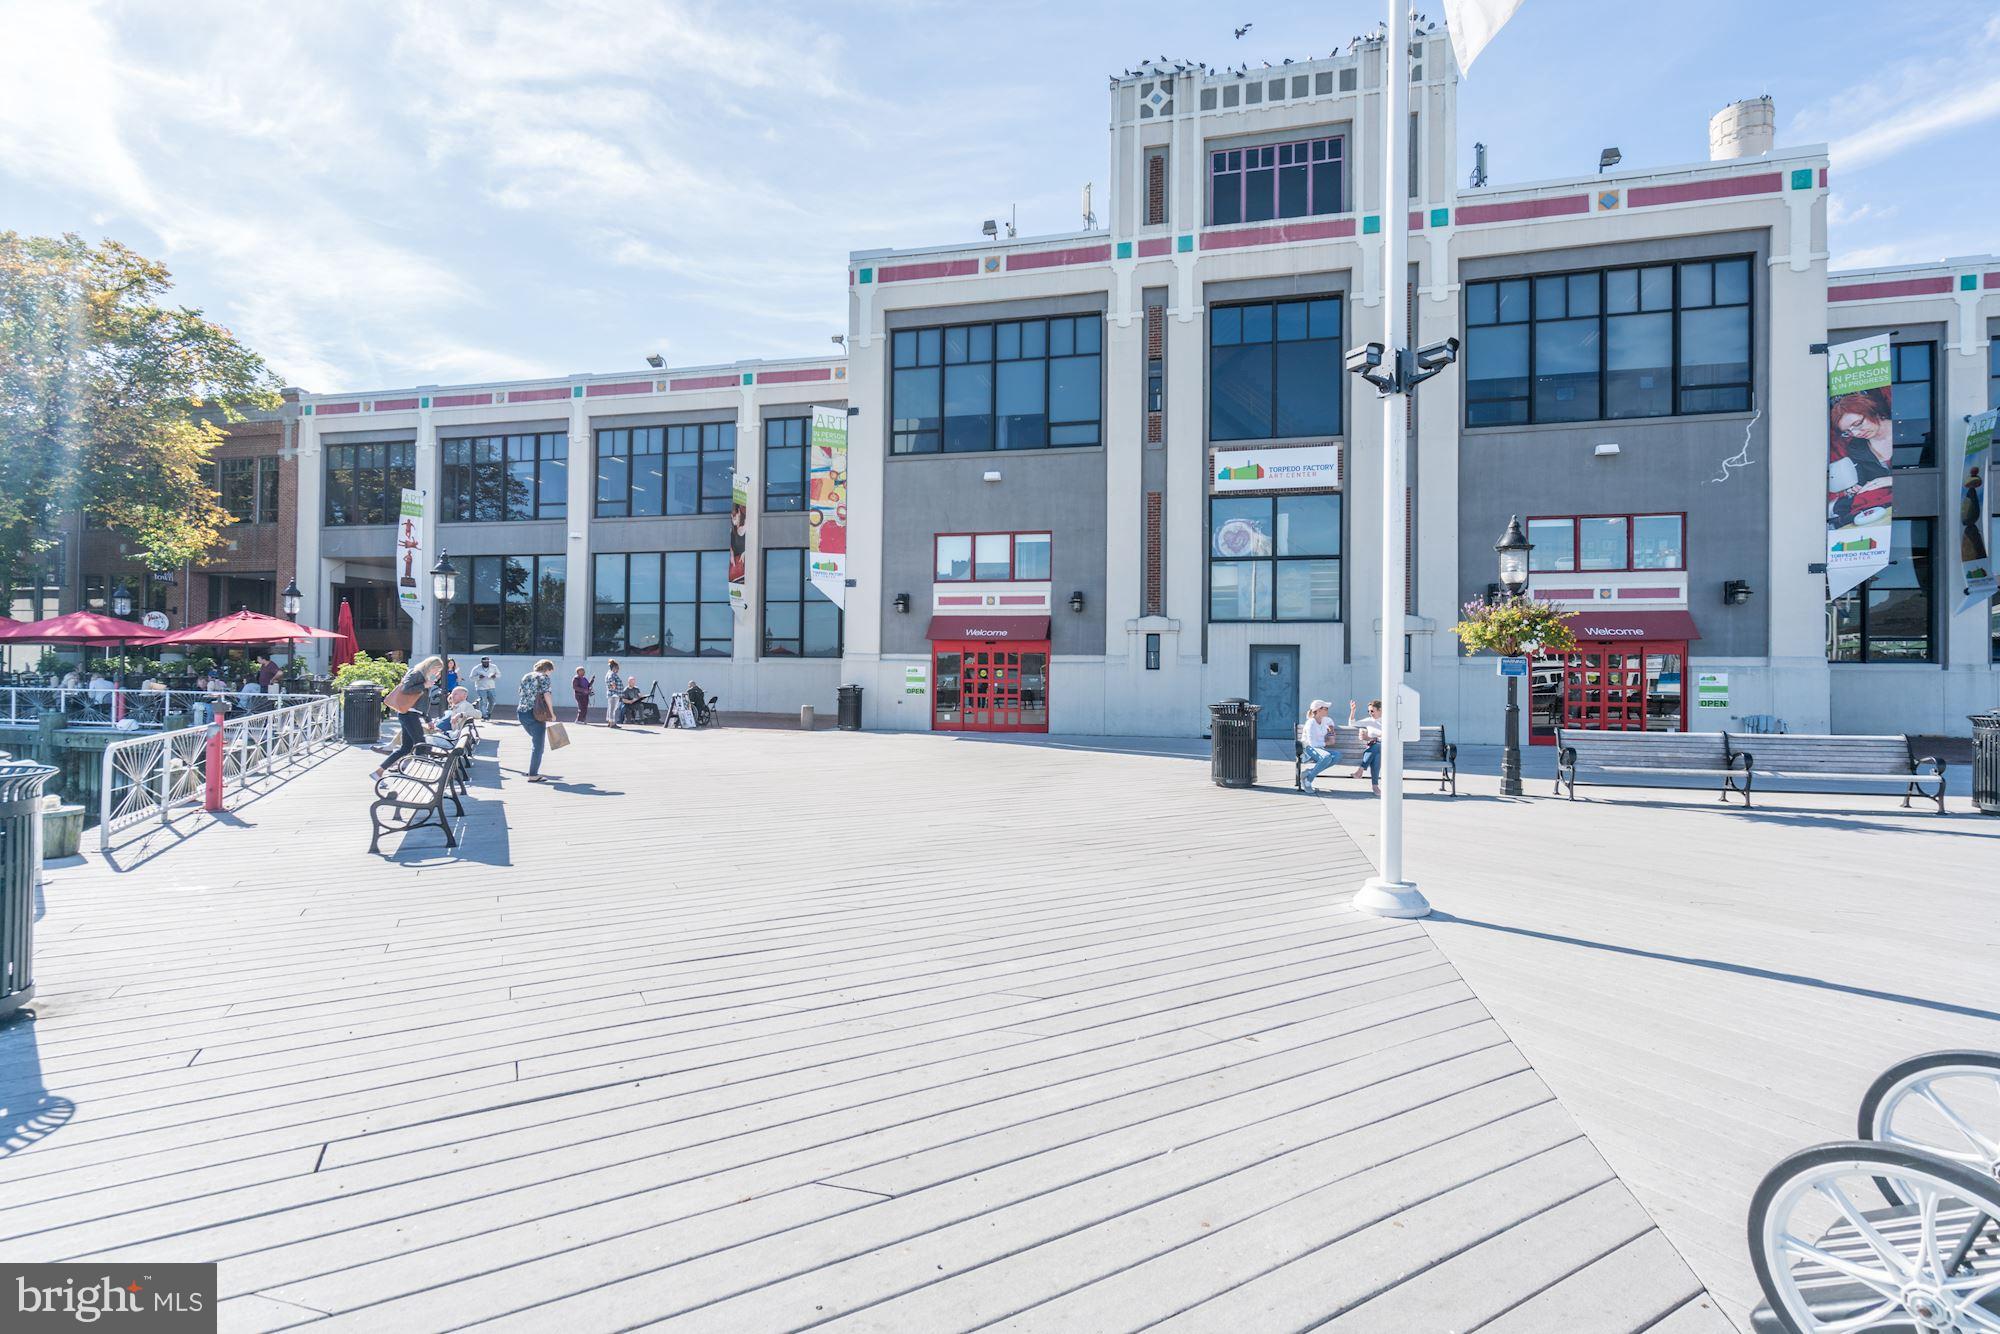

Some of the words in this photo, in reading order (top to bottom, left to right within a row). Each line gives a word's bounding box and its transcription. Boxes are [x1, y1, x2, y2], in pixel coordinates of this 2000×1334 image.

[1835, 343, 1888, 371] ART
[1831, 375, 1842, 384] IN
[1845, 367, 1889, 381] PERSON
[1848, 375, 1889, 387] PROGRESS
[815, 414, 845, 431] ART
[1268, 465, 1301, 473] TORPEDO
[1302, 463, 1335, 471] FACTORY
[965, 629, 1008, 637] Welcome
[1584, 627, 1645, 636] Welcome
